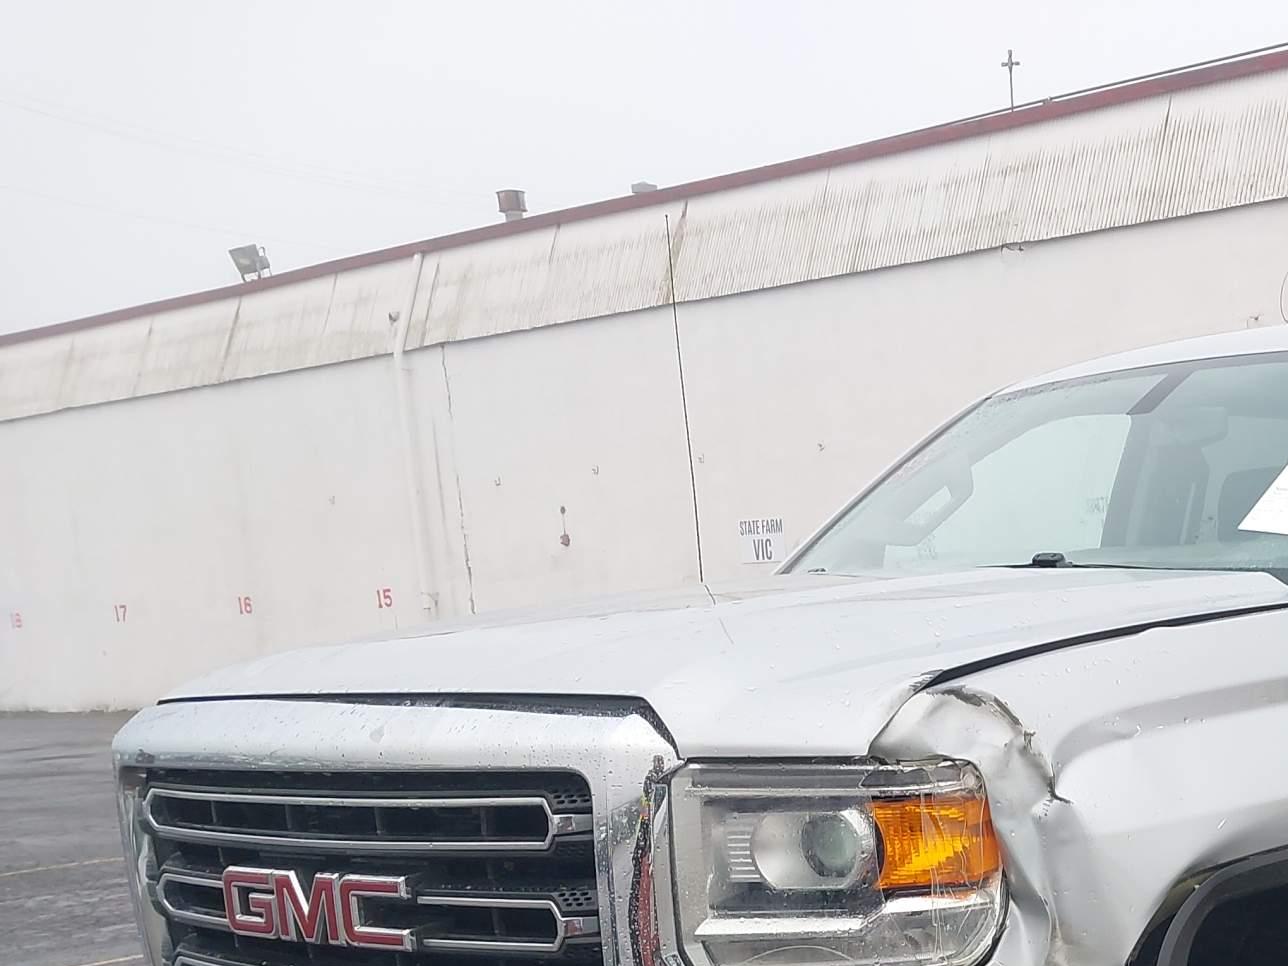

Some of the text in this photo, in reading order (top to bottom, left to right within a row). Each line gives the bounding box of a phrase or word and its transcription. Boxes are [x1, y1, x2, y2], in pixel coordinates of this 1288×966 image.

[740, 518, 783, 537] STATE FARM
[752, 538, 773, 561] VIC
[238, 596, 253, 615] 16
[376, 588, 393, 609] 15
[114, 604, 127, 623] 17
[222, 865, 417, 952] GMC
